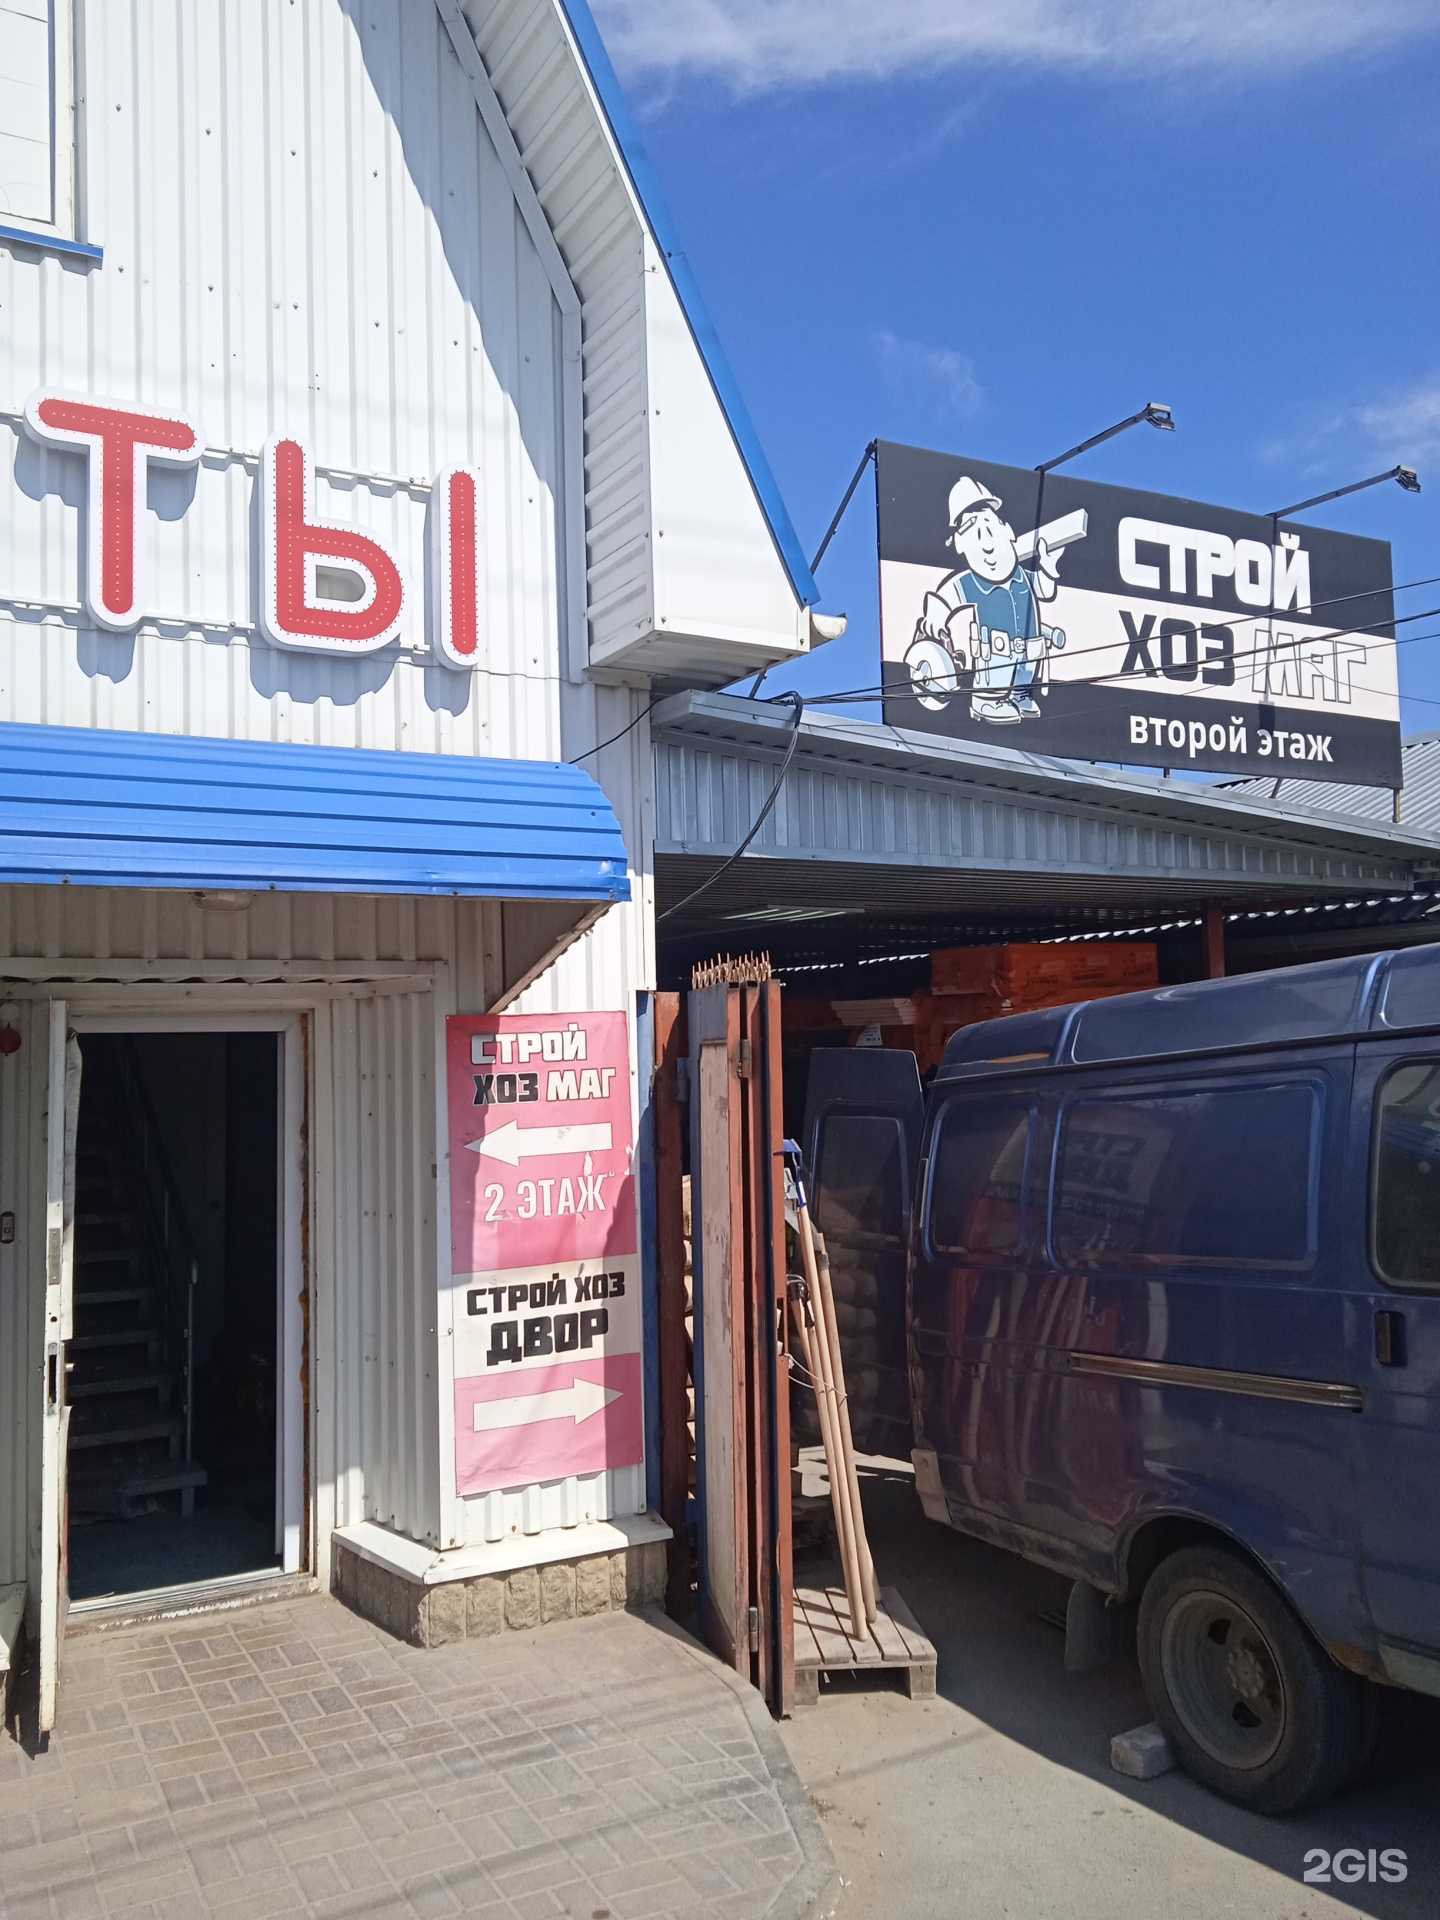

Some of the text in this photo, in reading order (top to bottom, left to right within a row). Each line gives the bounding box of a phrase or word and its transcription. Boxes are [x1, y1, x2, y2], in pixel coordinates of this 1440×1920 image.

[27, 389, 483, 667] ТЫ
[1117, 515, 1312, 614] СТРОЙ
[1119, 609, 1367, 704] ХОЗ МАГ
[1257, 729, 1334, 762] этаж
[471, 1023, 587, 1065] СТРОЙ
[473, 1067, 616, 1105] ХОЗ МАГ
[484, 1174, 606, 1222] 2 ЭТАЖ
[466, 1271, 625, 1316] СТРОЙ ХОЗ
[486, 1308, 609, 1367] ДВОР
